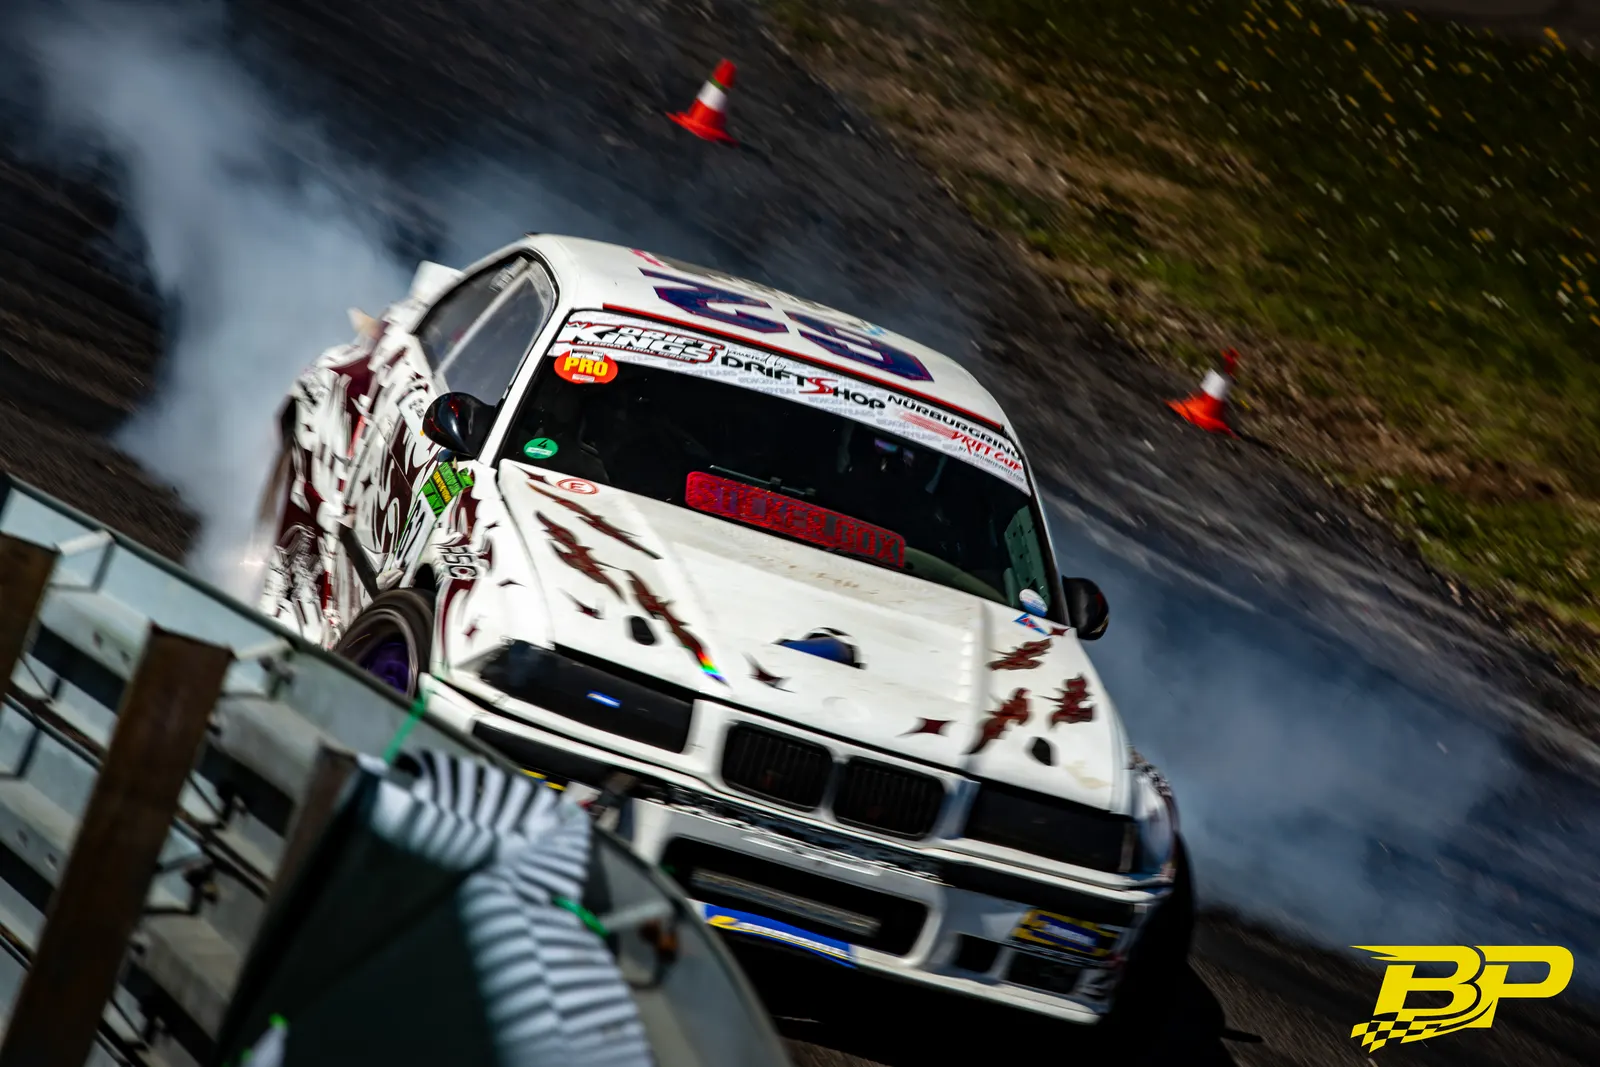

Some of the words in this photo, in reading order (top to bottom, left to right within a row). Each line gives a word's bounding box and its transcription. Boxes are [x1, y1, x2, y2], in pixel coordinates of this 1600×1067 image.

[556, 326, 711, 360] KINGS
[618, 326, 723, 350] DRIFT
[563, 356, 609, 377] PRO
[537, 437, 549, 449] 4
[993, 452, 1023, 471] CUP
[697, 479, 827, 540] STICKER
[834, 519, 897, 563] BOX
